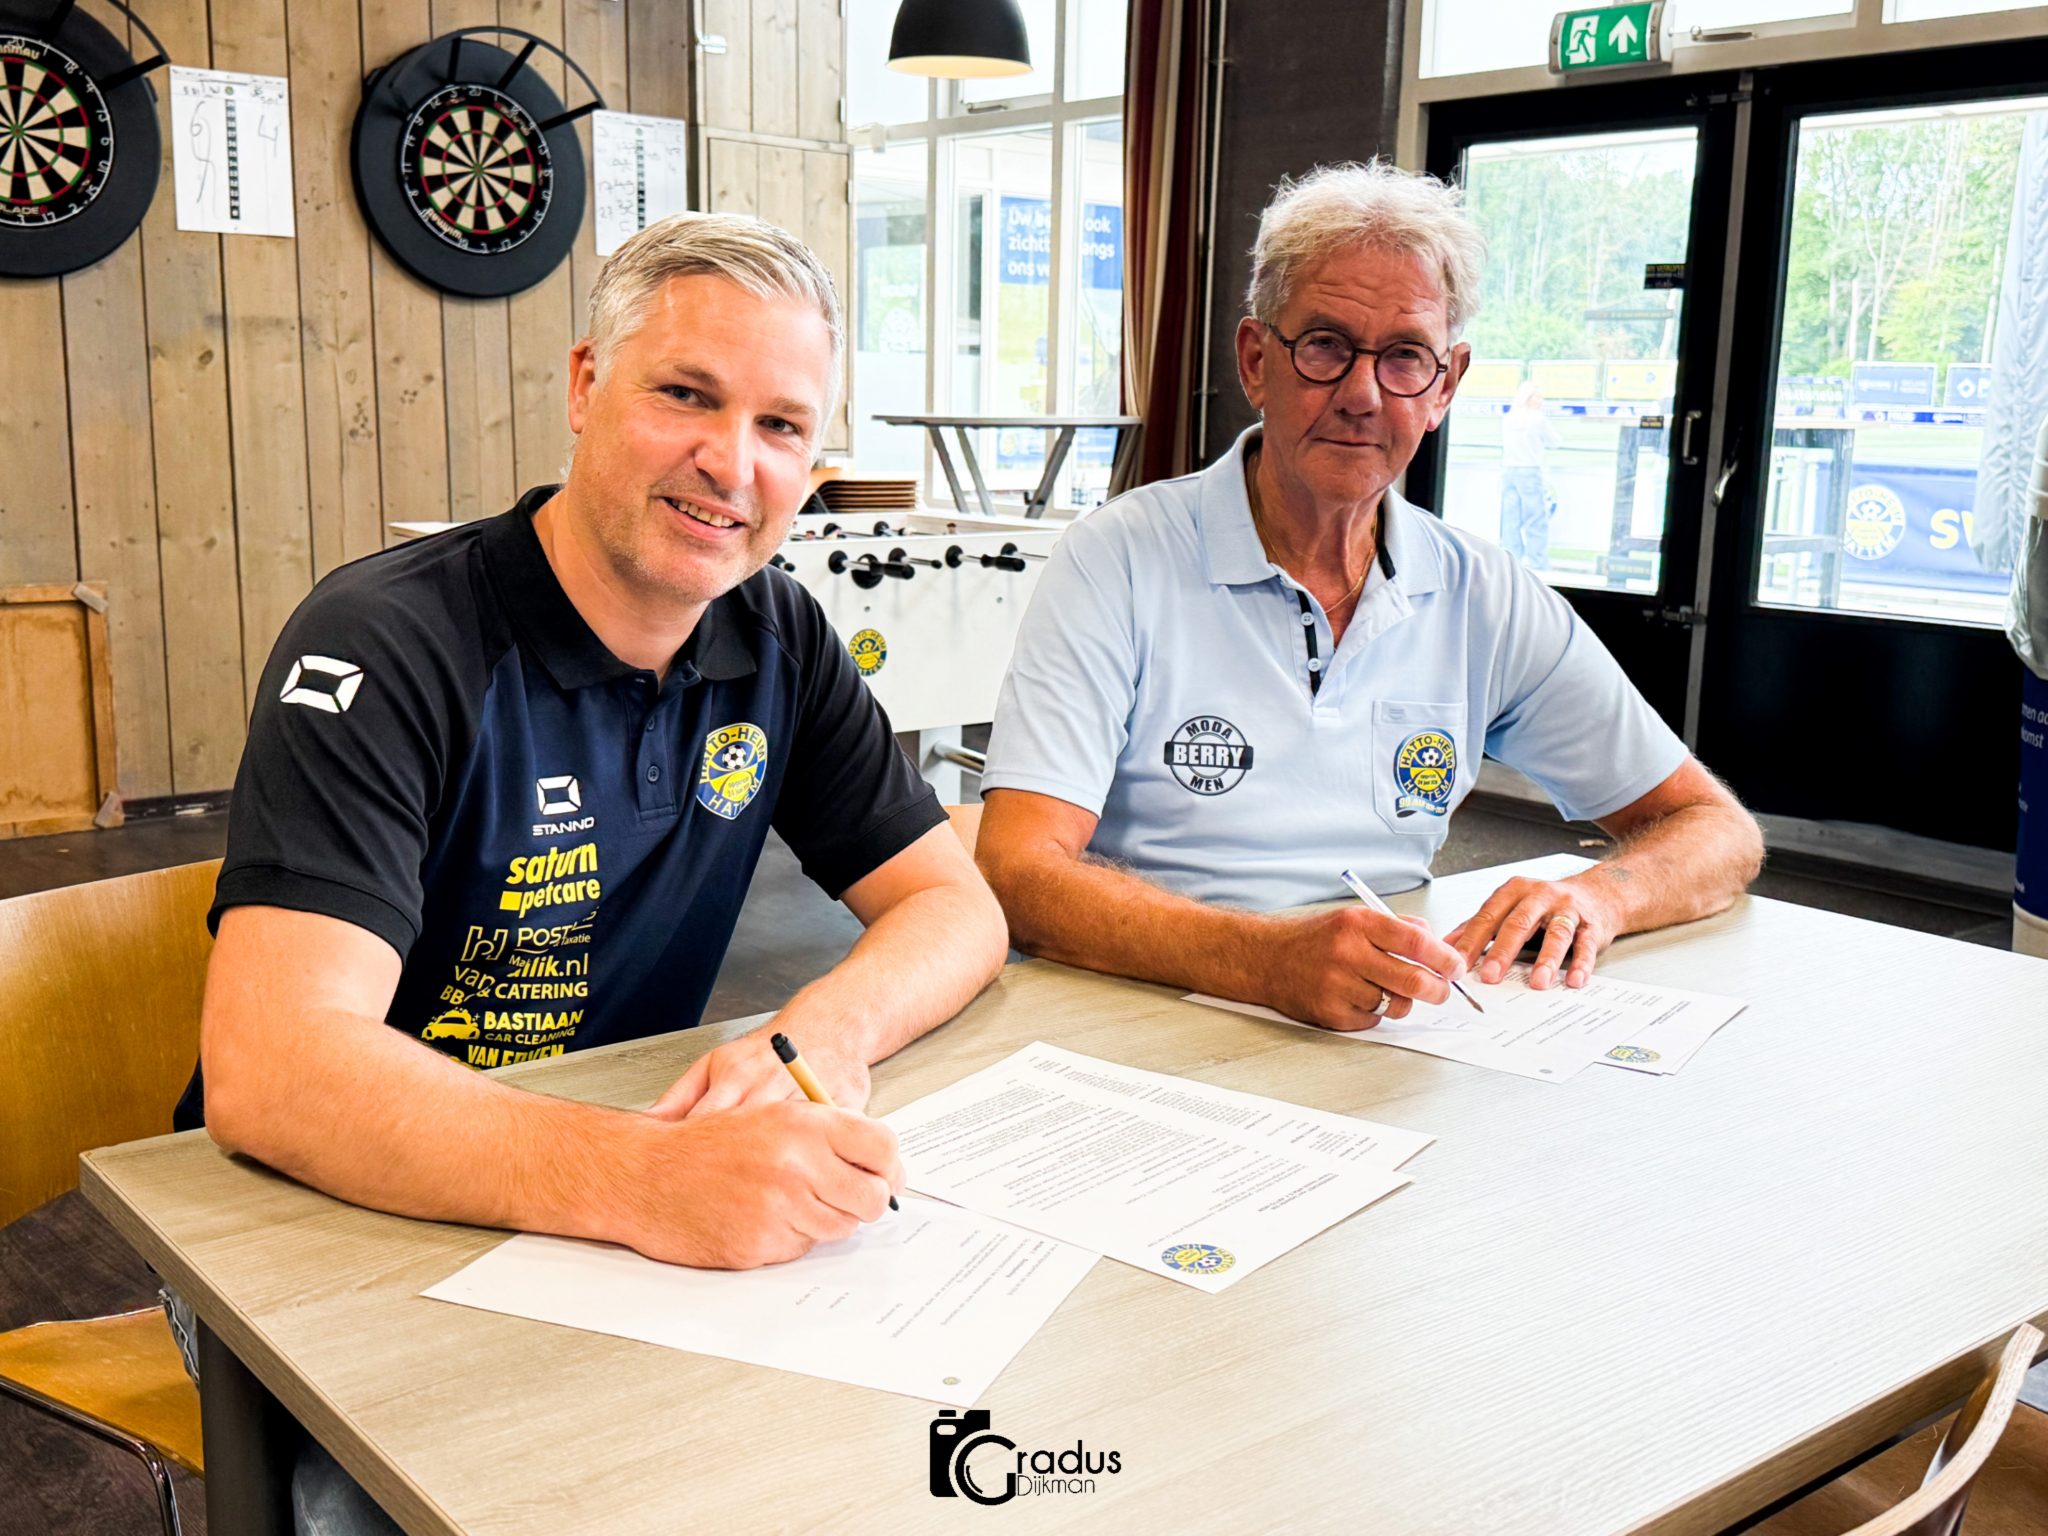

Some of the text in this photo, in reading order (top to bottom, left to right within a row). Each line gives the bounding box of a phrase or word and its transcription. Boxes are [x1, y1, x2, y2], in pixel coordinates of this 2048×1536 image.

[1084, 215, 1112, 234] ook
[1007, 261, 1035, 277] ons
[1185, 719, 1233, 740] MODA
[1173, 743, 1246, 768] BERRY
[1400, 735, 1454, 768] HATTO-HEIM
[1190, 775, 1225, 792] MEN
[1403, 778, 1451, 802] HATTEM
[532, 816, 595, 837] STANNO
[505, 842, 598, 885] saturn
[518, 878, 600, 919] petcare
[516, 925, 573, 948] POST
[494, 981, 589, 1000] CATERING
[483, 1009, 584, 1031] BASTIAAN
[485, 1027, 576, 1045] CAR CLEANING
[467, 1044, 498, 1067] VAN
